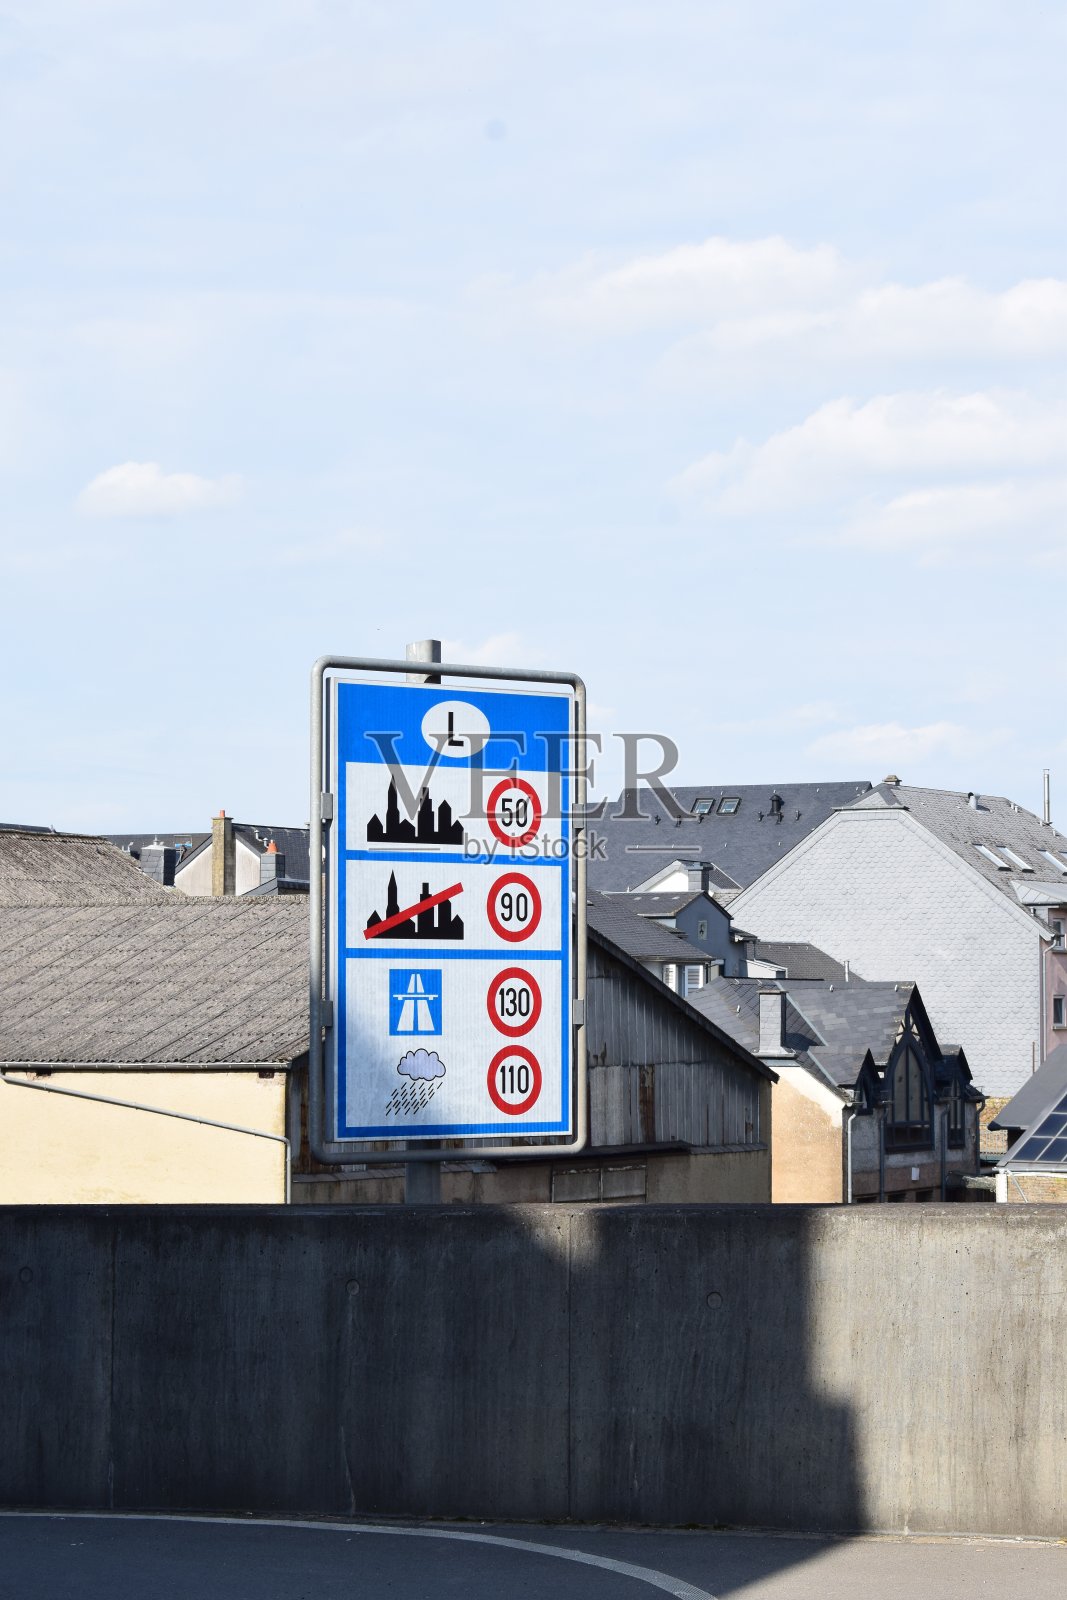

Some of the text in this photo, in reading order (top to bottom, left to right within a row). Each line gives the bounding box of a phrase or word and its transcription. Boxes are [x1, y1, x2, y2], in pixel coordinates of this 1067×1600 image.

[448, 711, 464, 747] L
[501, 798, 528, 828] 50
[501, 892, 528, 922] 90
[499, 987, 530, 1017] 130
[500, 1065, 529, 1094] 110
